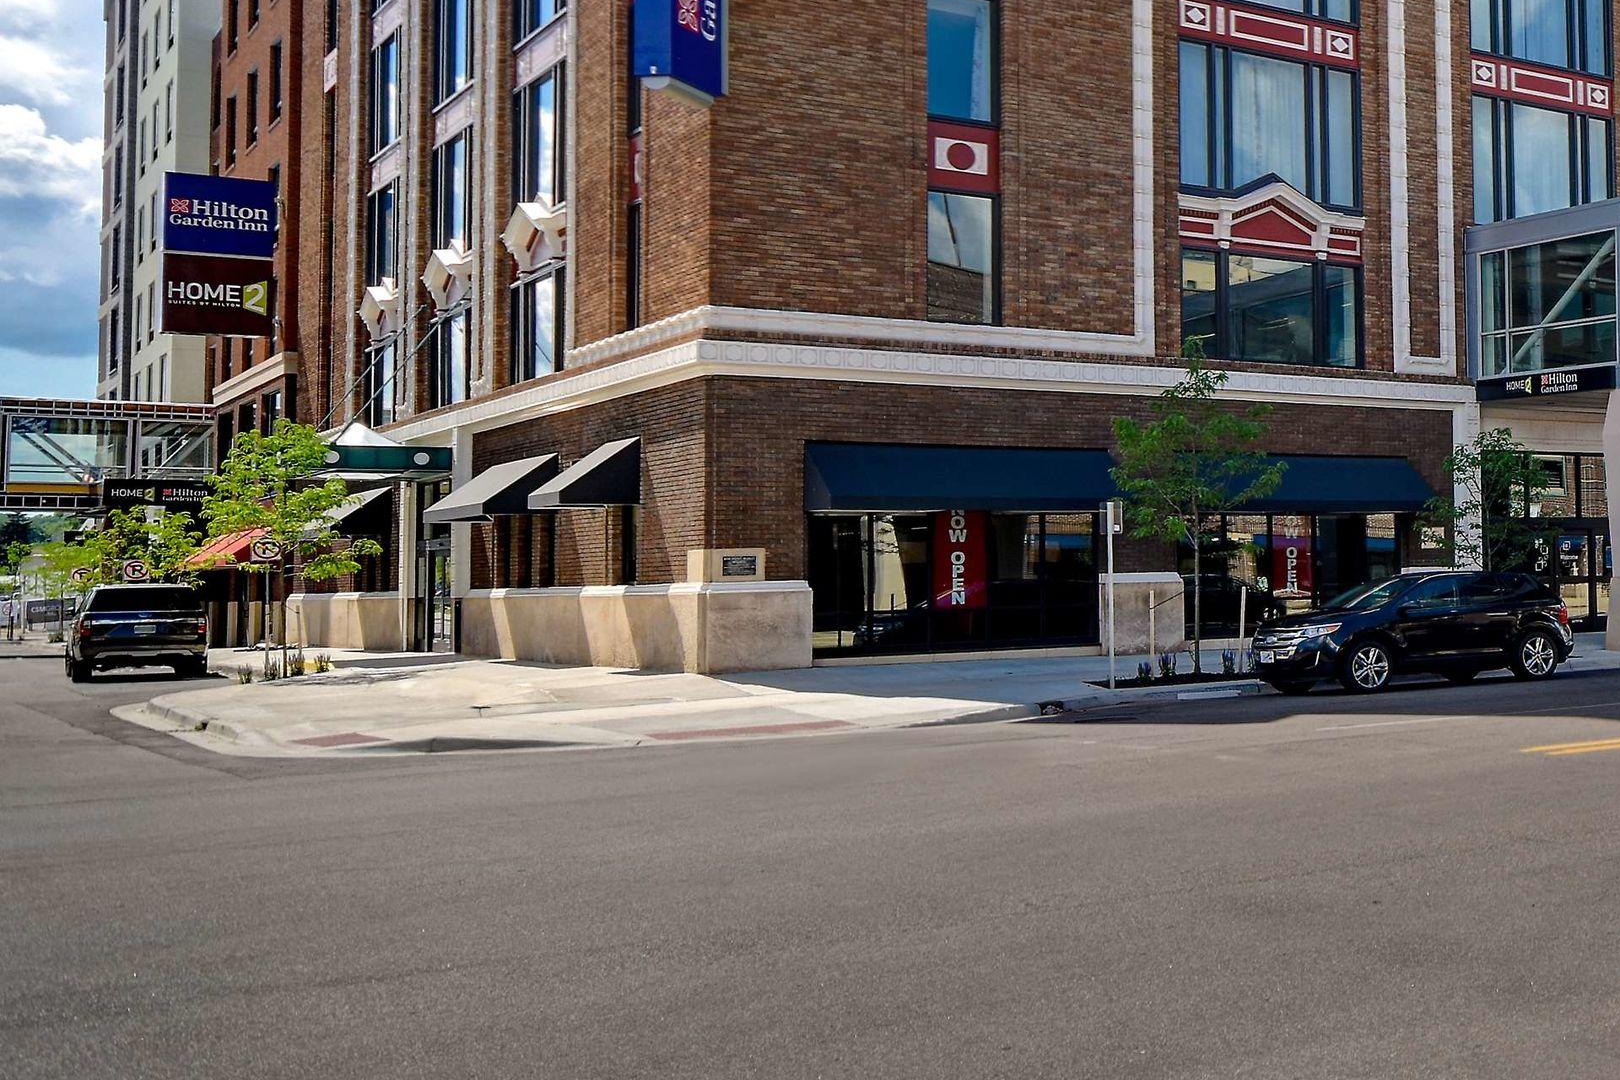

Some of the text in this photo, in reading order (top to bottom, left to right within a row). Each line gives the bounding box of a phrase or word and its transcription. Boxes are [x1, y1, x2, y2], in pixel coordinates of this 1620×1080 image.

[192, 199, 268, 220] Hilton
[169, 214, 268, 232] Garden Inn
[1548, 373, 1578, 385] Hilton
[1541, 383, 1578, 394] Garden Inn
[173, 488, 208, 497] Hilton
[950, 551, 966, 605] OPEN
[1286, 546, 1298, 595] OPEN
